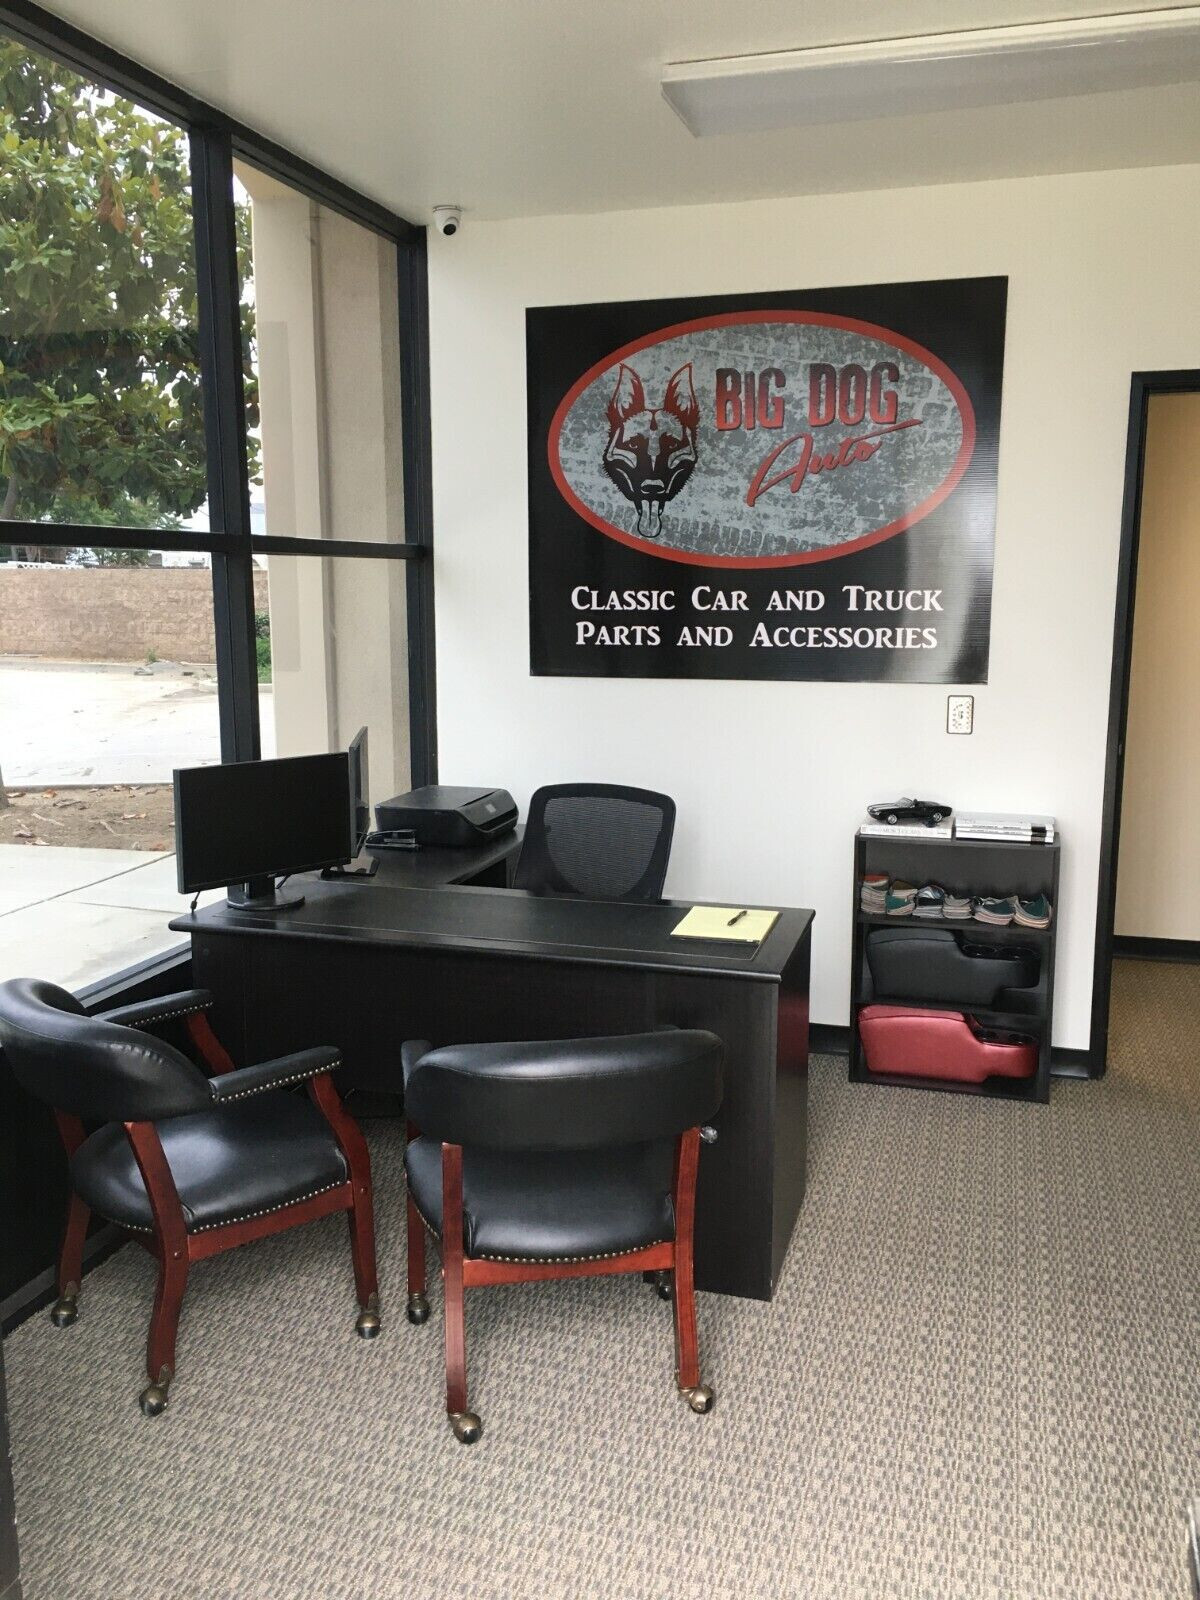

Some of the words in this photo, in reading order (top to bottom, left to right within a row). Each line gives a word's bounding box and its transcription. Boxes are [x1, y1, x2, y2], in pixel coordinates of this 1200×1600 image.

[715, 367, 786, 431] BIG
[808, 361, 900, 427] DOG
[746, 417, 923, 507] Auto
